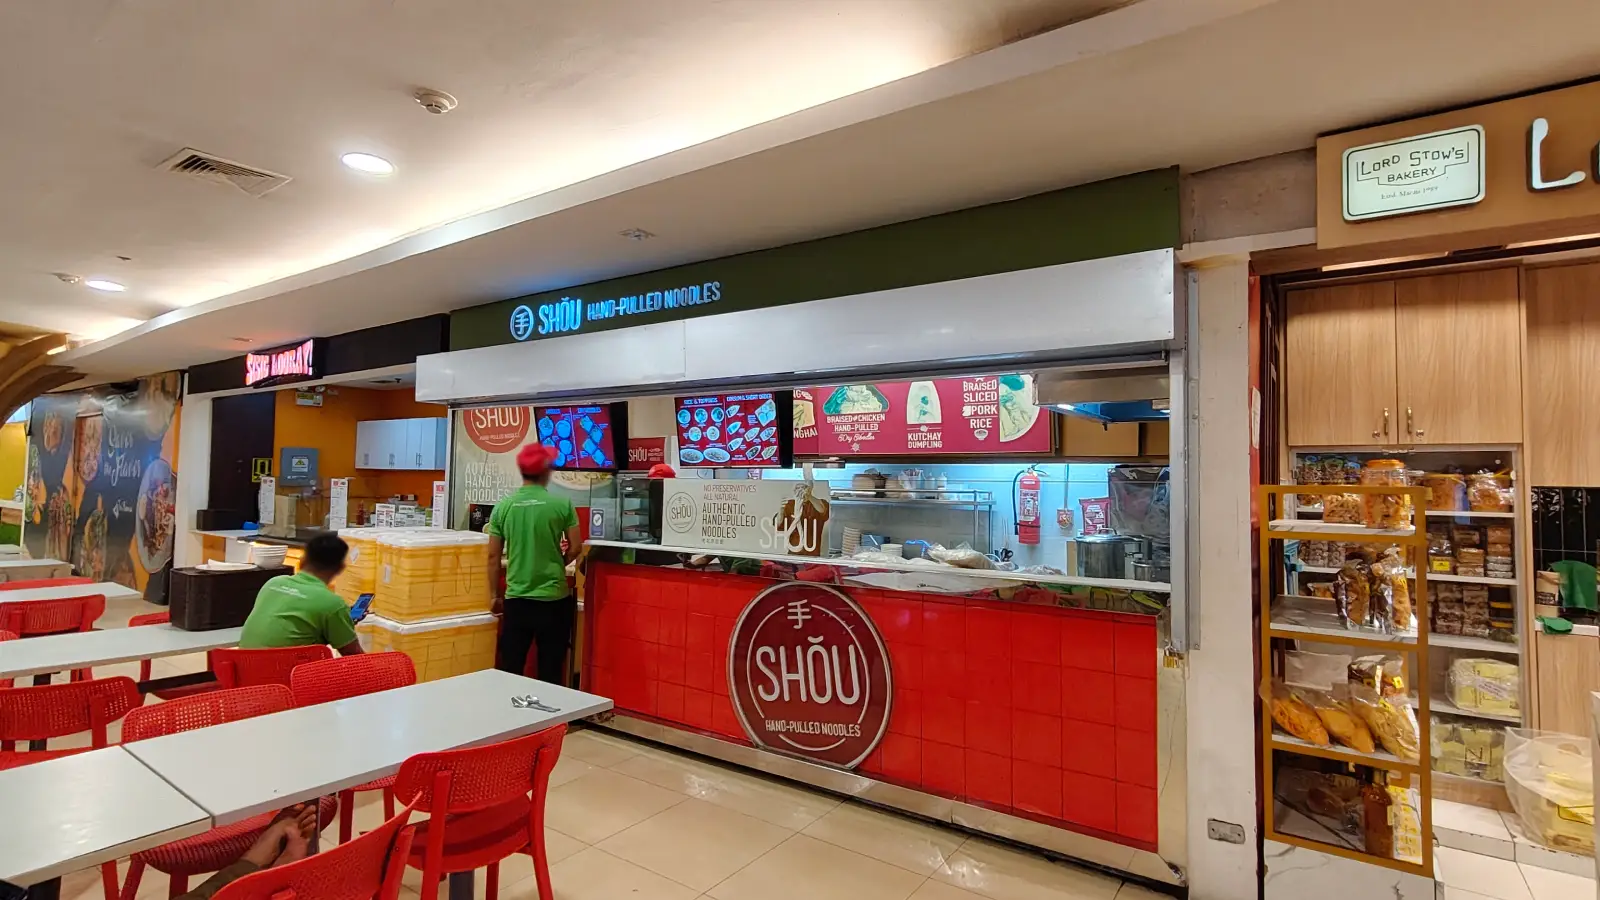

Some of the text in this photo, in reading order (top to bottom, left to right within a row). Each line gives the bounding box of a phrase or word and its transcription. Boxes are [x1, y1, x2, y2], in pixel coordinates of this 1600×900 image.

[1361, 147, 1464, 175] LORD STOW'S
[1387, 166, 1437, 182] BAKERY
[587, 292, 662, 321] HAND-PULLED
[664, 281, 721, 309] NOODLES
[245, 353, 270, 386] SISIG
[963, 380, 997, 391] BRAISED
[963, 391, 997, 402] SLICED
[971, 404, 998, 415] PORK
[827, 413, 885, 423] BRAISED CHICKEN
[970, 418, 992, 428] RICE
[834, 423, 879, 432] HAND-PULLED
[907, 432, 942, 441] KUTCHAY
[907, 440, 942, 449] DUMPLING
[703, 484, 757, 493] NO PRESERVATIVES
[703, 493, 740, 502] ALL NATURAL
[702, 502, 746, 515] AUTHENTIC
[702, 514, 757, 527] HAND-PULLED
[701, 526, 737, 539] NOODLES
[787, 599, 812, 629] 手
[765, 719, 861, 737] HAND-PULLED NOODLES
